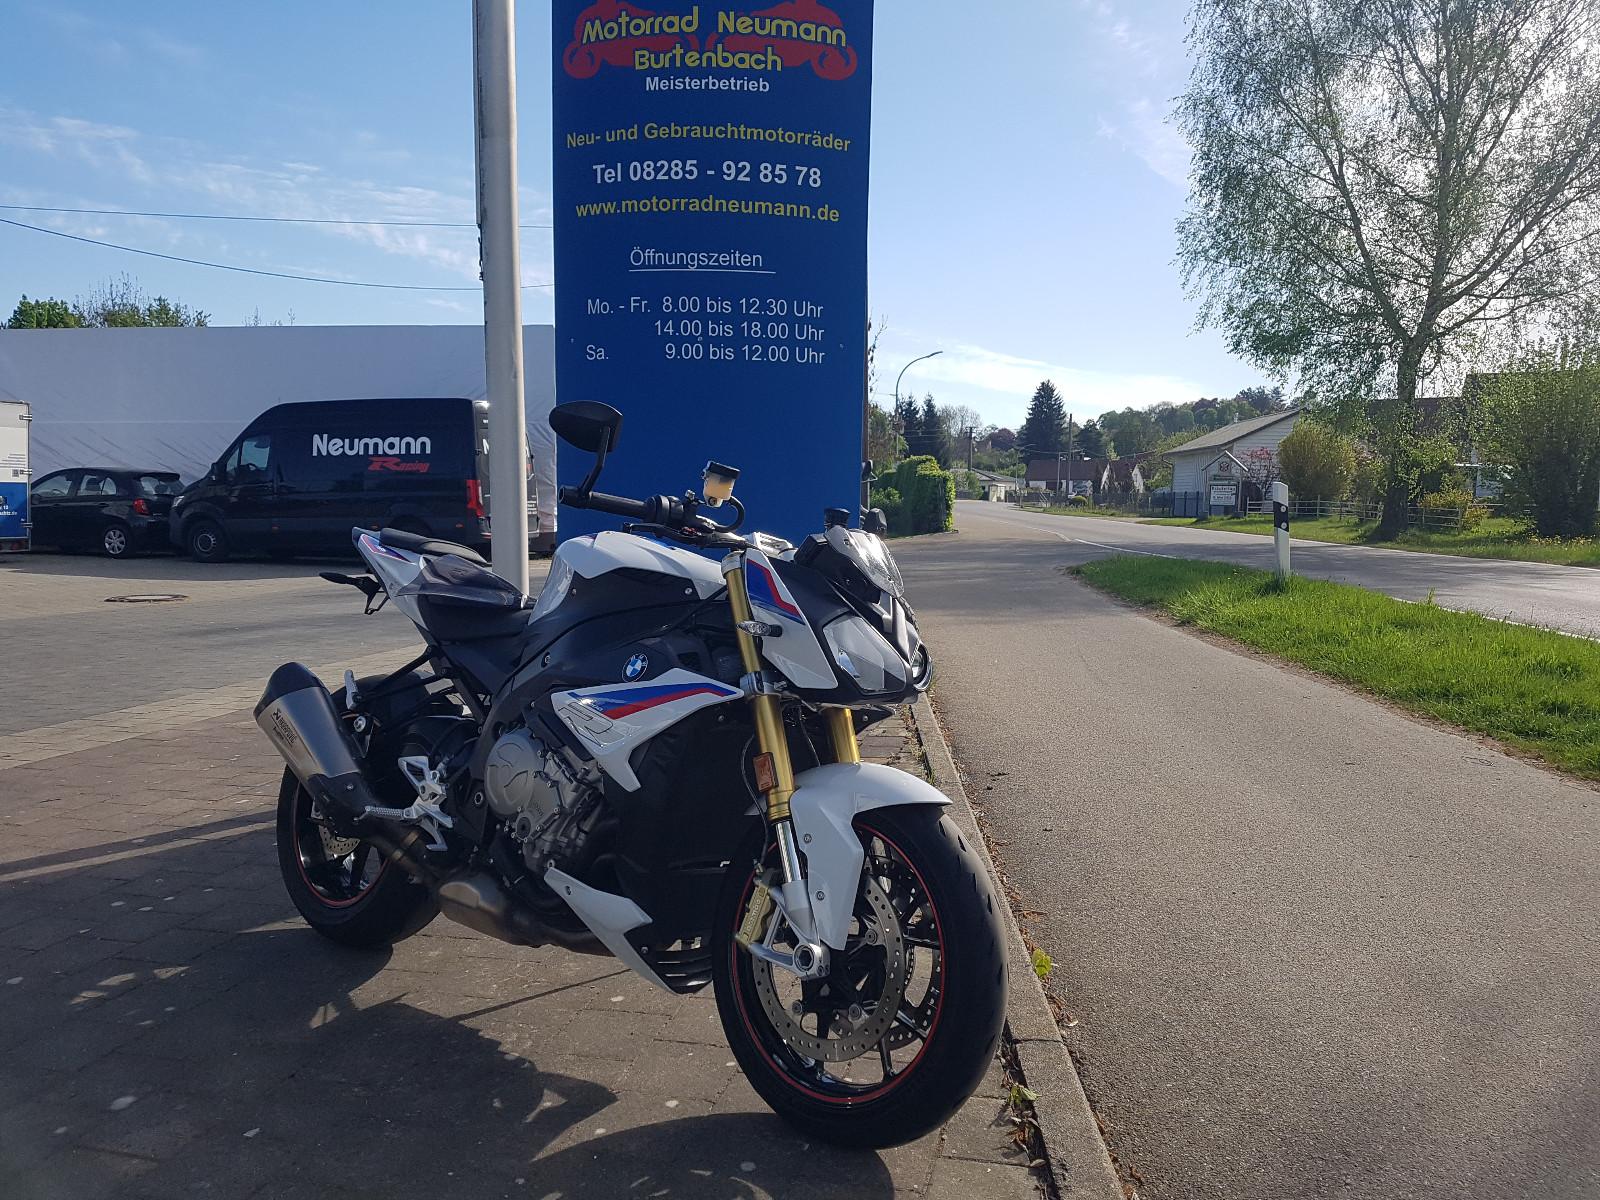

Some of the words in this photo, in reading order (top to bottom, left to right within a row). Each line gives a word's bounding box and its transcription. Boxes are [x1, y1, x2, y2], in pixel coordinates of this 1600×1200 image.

[582, 6, 699, 44] Motorrad
[717, 11, 847, 47] Neumann
[634, 43, 782, 71] Burtenbach
[645, 75, 770, 92] Meisterbetrieb
[566, 132, 601, 149] Neu-
[605, 124, 638, 142] und
[644, 122, 851, 152] Gebrauchtmotorräder
[592, 162, 622, 184] Tel
[629, 159, 698, 181] 08285
[722, 160, 751, 182] 92
[759, 162, 787, 184] 85
[795, 165, 822, 188] 78
[575, 194, 840, 222] www.motorradneumann.de
[630, 246, 762, 269] Öffnungszeiten
[587, 298, 614, 315] Mo.
[630, 296, 651, 313] Fr.
[662, 296, 700, 313] 8.00
[706, 296, 732, 314] bis
[739, 297, 788, 316] 12.30
[793, 300, 824, 318] Uhr
[654, 319, 702, 337] 14.00
[708, 320, 734, 337] bis
[740, 321, 789, 340] 18.00
[795, 323, 825, 341] Uhr
[586, 344, 609, 360] Sa.
[665, 343, 703, 360] 9.00
[709, 343, 735, 360] bis
[741, 344, 789, 362] 12.00
[795, 346, 825, 364] Uhr
[312, 433, 431, 456] Neumann
